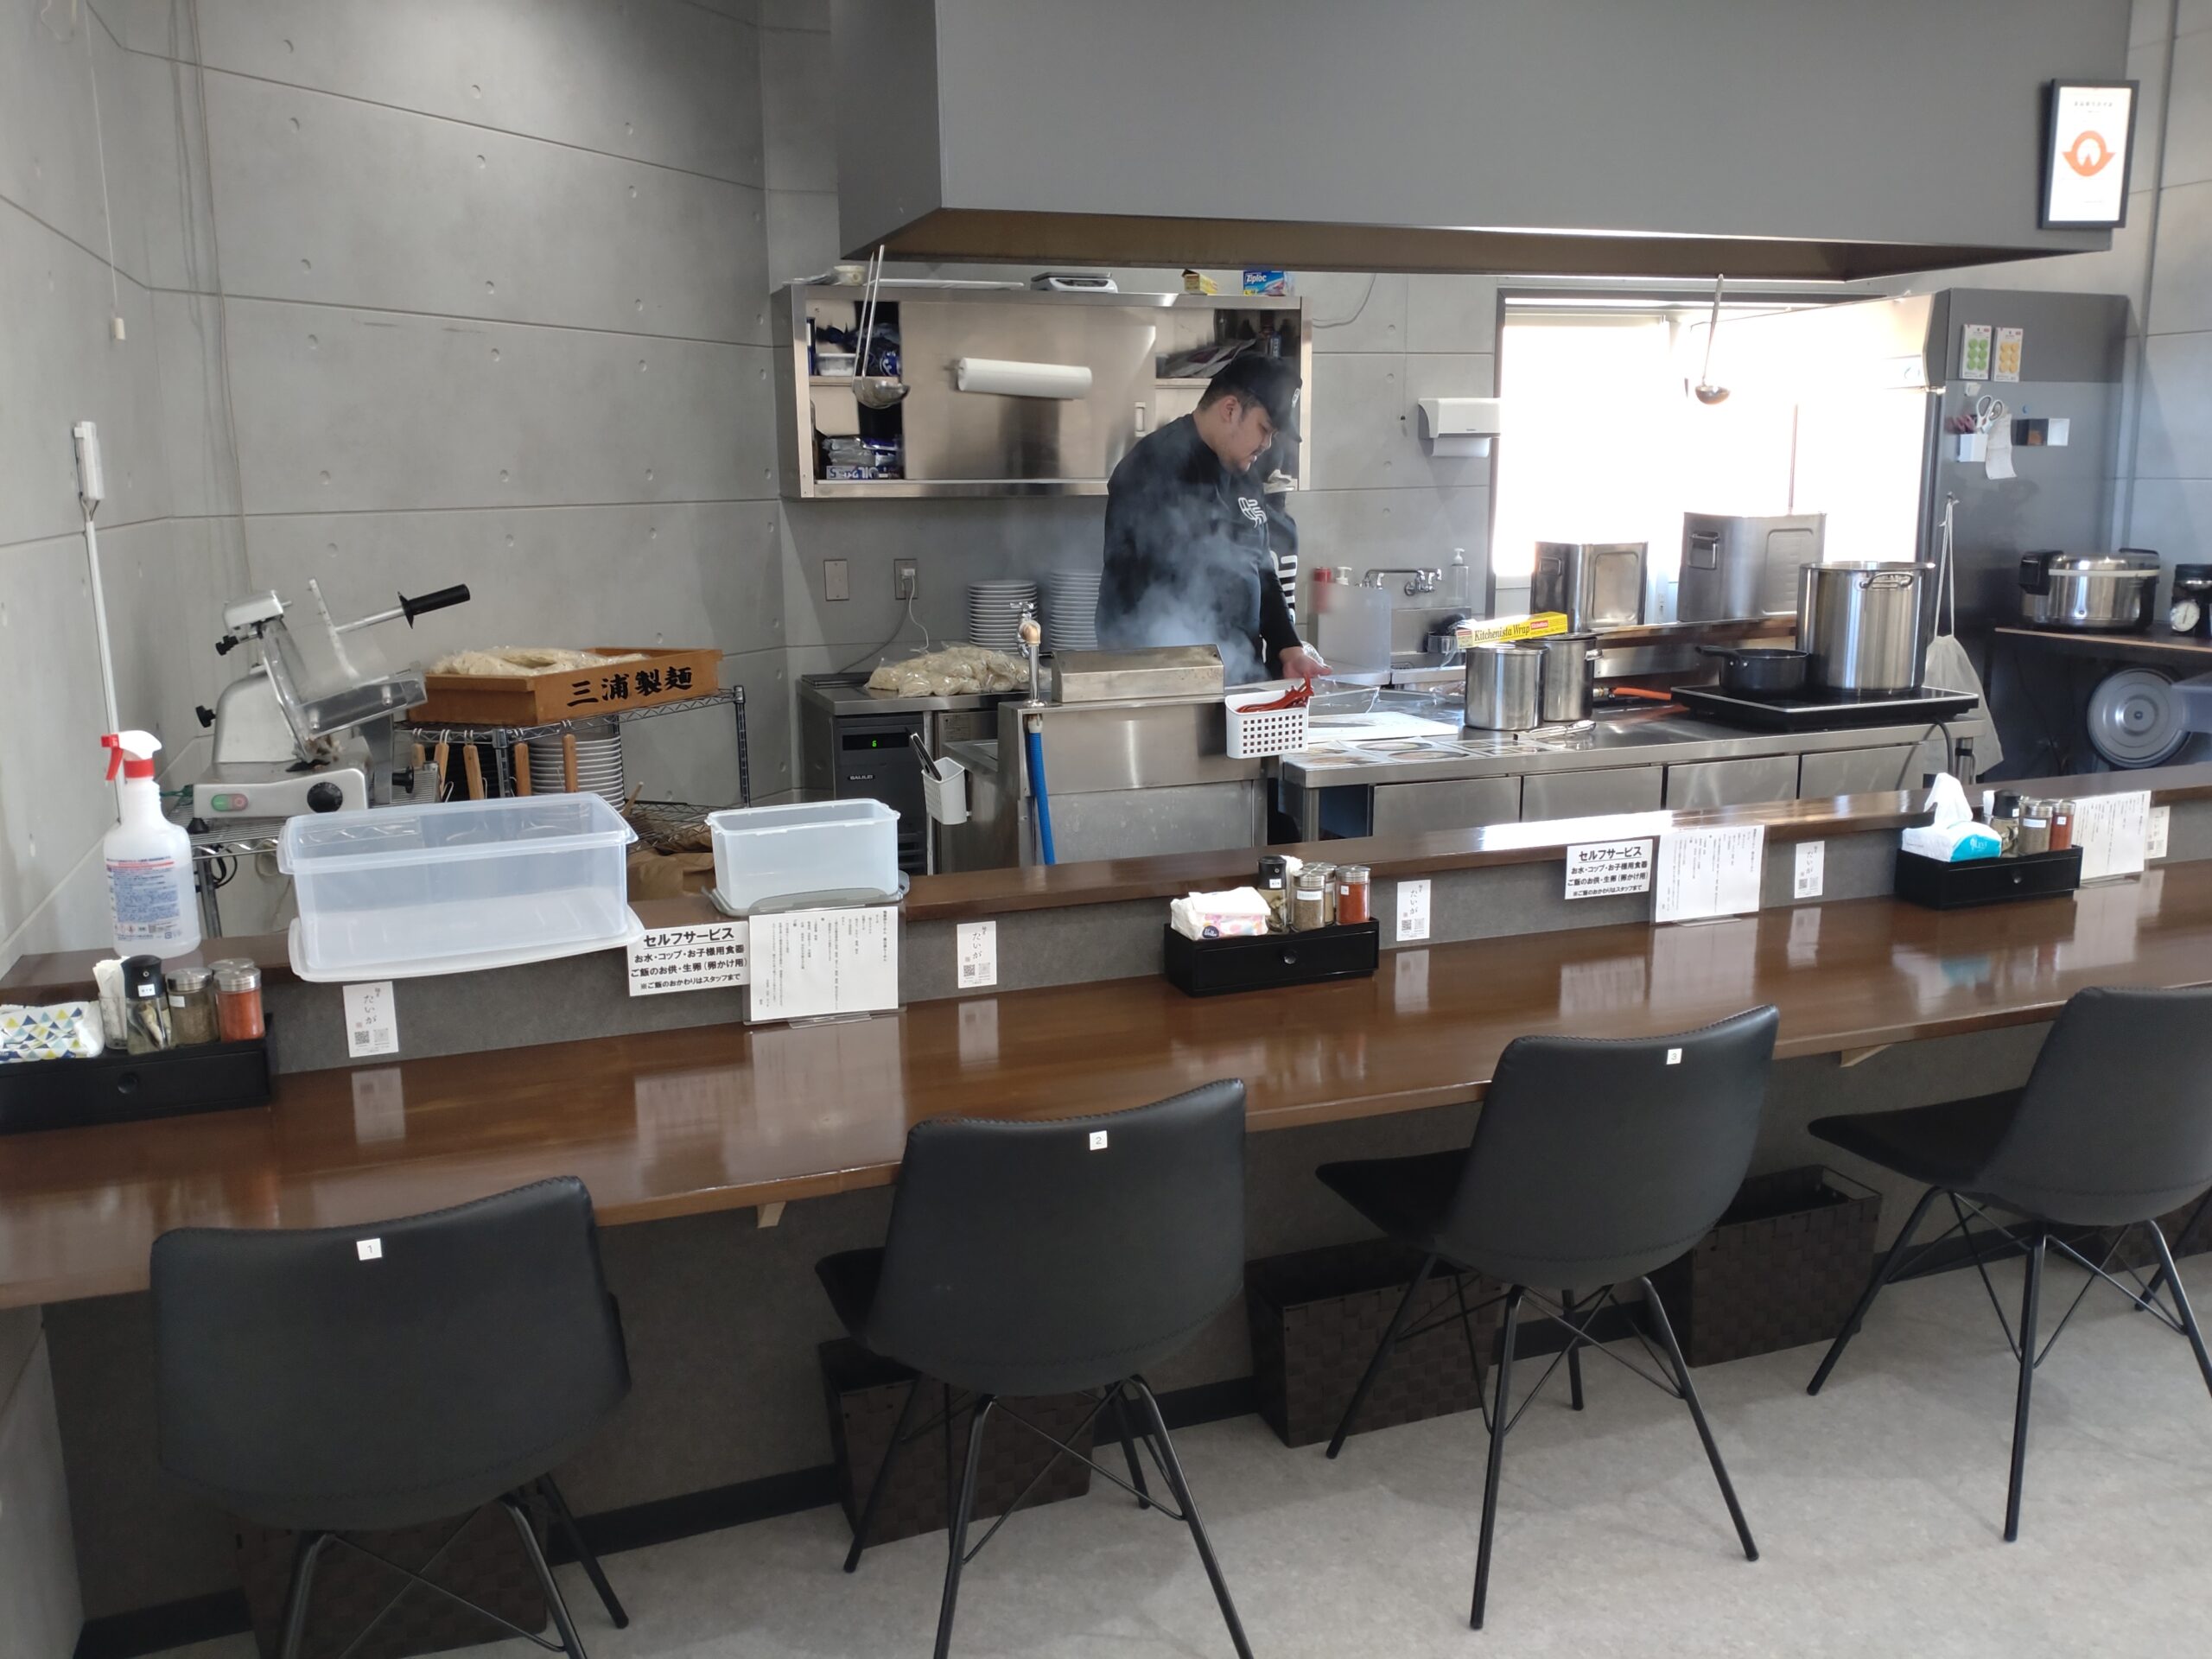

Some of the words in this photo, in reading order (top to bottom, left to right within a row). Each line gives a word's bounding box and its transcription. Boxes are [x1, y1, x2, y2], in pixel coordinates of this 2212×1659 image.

[1246, 274, 1267, 284] Ziploc
[1474, 626, 1512, 641] Kitchenista
[1513, 624, 1530, 636] Wrap
[567, 666, 693, 707] 三浦製麺
[1579, 847, 1642, 861] セルフサービス
[643, 927, 734, 947] セルフサービス
[1096, 1136, 1103, 1145] 2
[367, 1245, 372, 1254] 1
